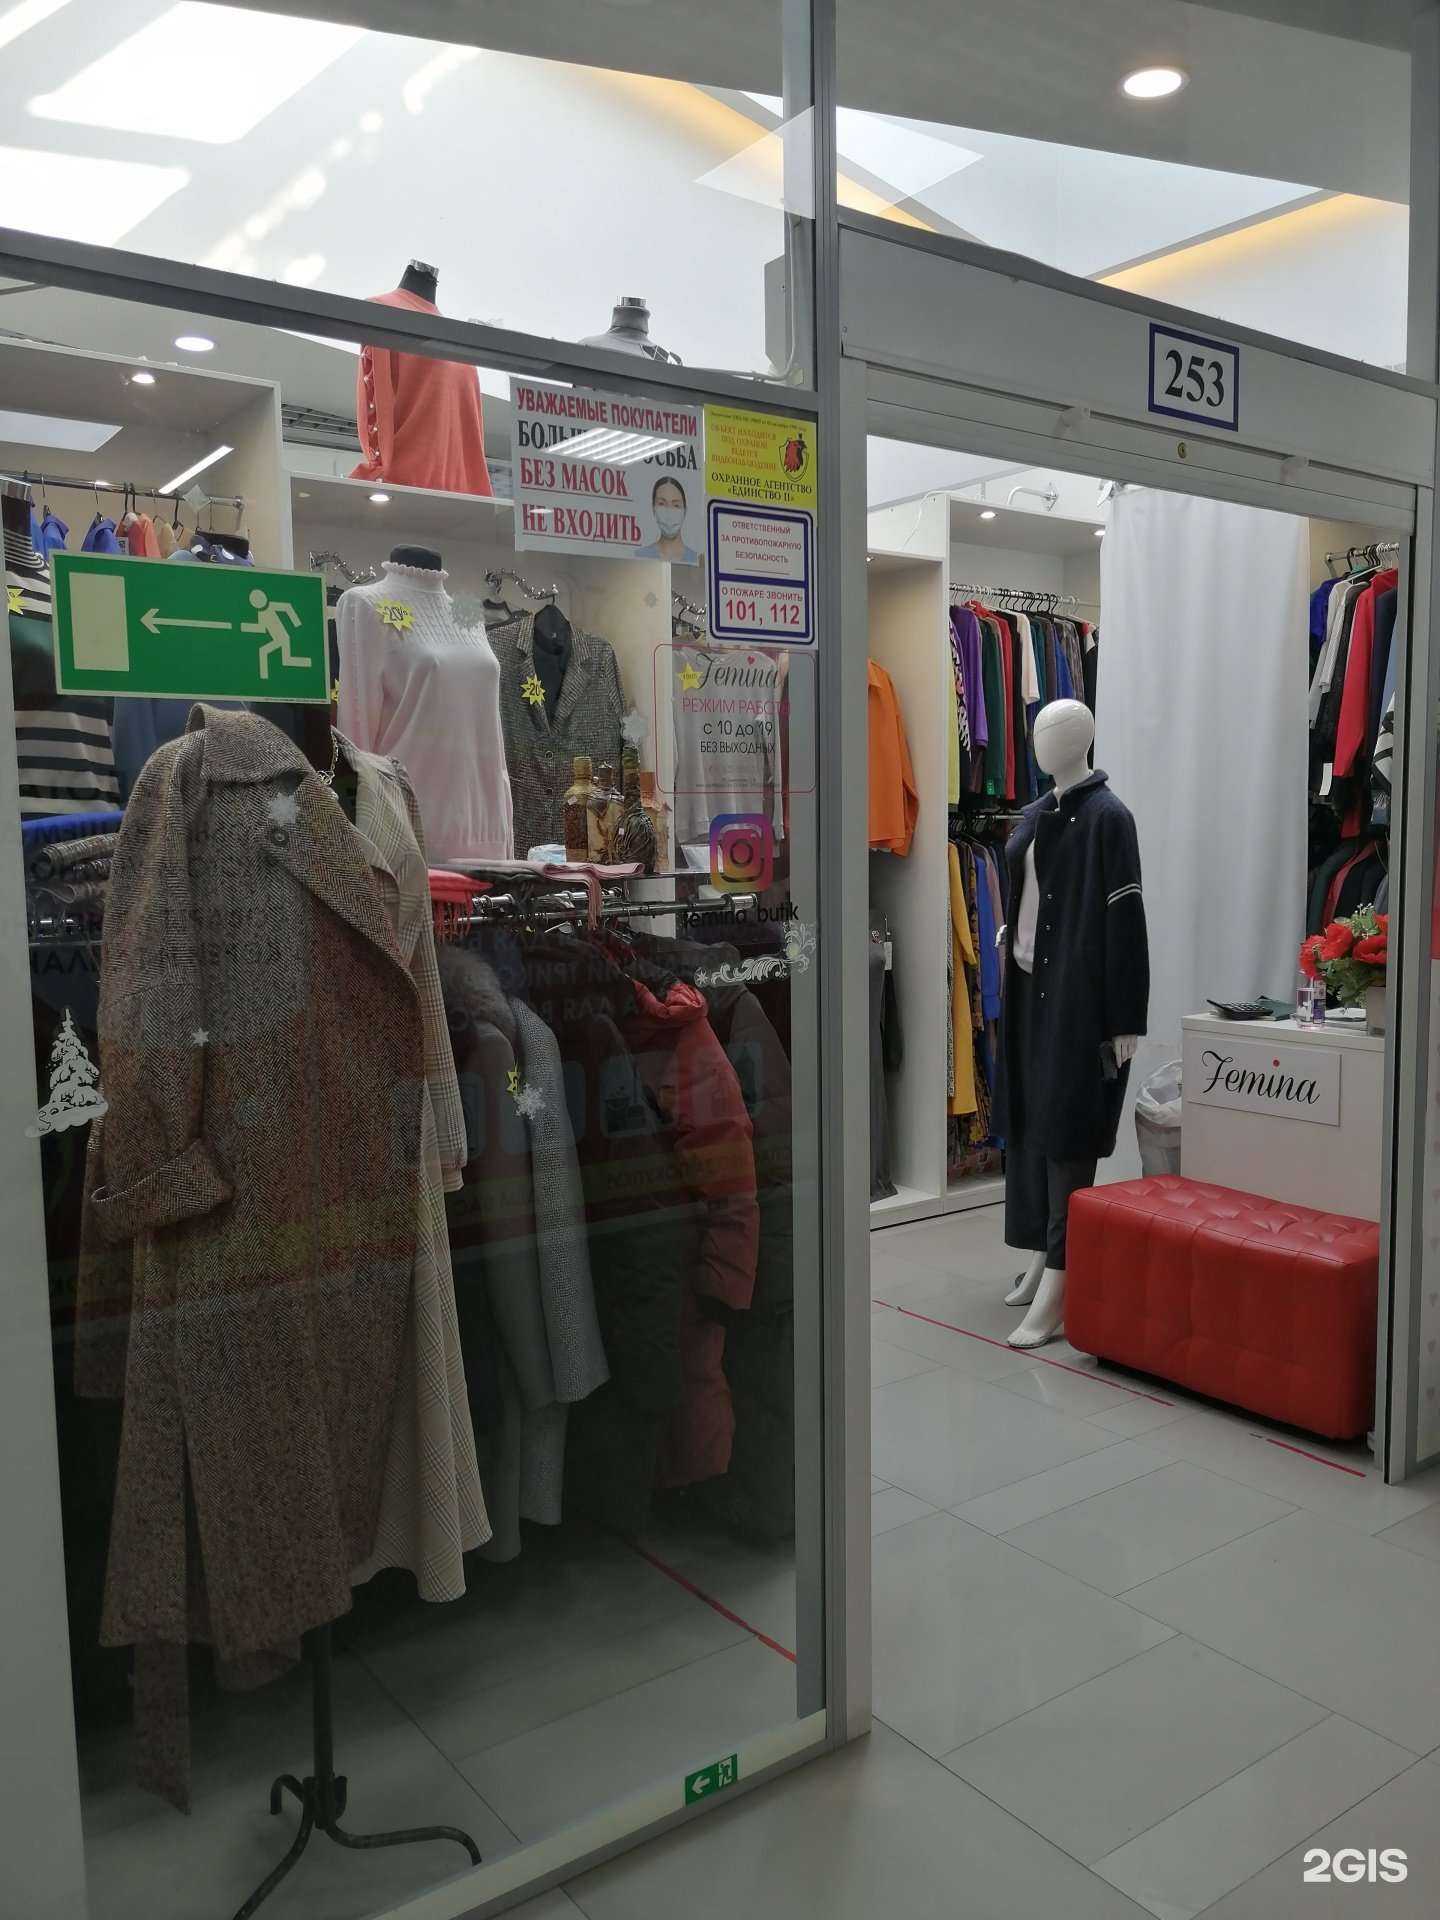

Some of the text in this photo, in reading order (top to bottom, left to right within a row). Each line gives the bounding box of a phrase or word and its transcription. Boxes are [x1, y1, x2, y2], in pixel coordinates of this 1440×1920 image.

[1165, 349, 1224, 407] 253
[517, 387, 608, 424] УВАЖАЕМЫЕ
[611, 404, 697, 437] ПОКУПАТЕЛИ
[520, 457, 628, 497] БЕЗ МАСОК
[711, 472, 812, 494] ОХРАННОЕ АГЕНТСТВО
[522, 503, 641, 543] НЕ ВХОДИТЬ
[732, 520, 791, 534] ОТВЕТСТВЕННЫЙ
[721, 534, 802, 551] ЗА ПРОТИВОПОЖАРНУЮ
[735, 550, 788, 563] БЕЗОПАСНОСТЬ
[721, 587, 803, 602] О ПОЖАРЕ ЗВОНИТЬ
[726, 599, 800, 625] 101, 112
[696, 652, 782, 689] Femina
[682, 696, 735, 713] РЕЖИМ
[717, 720, 733, 736] 10
[735, 724, 754, 738] до
[759, 721, 773, 736] 19
[700, 741, 776, 754] БЕЗ ВЫХОДНЫХ
[1202, 1050, 1321, 1105] Femina
